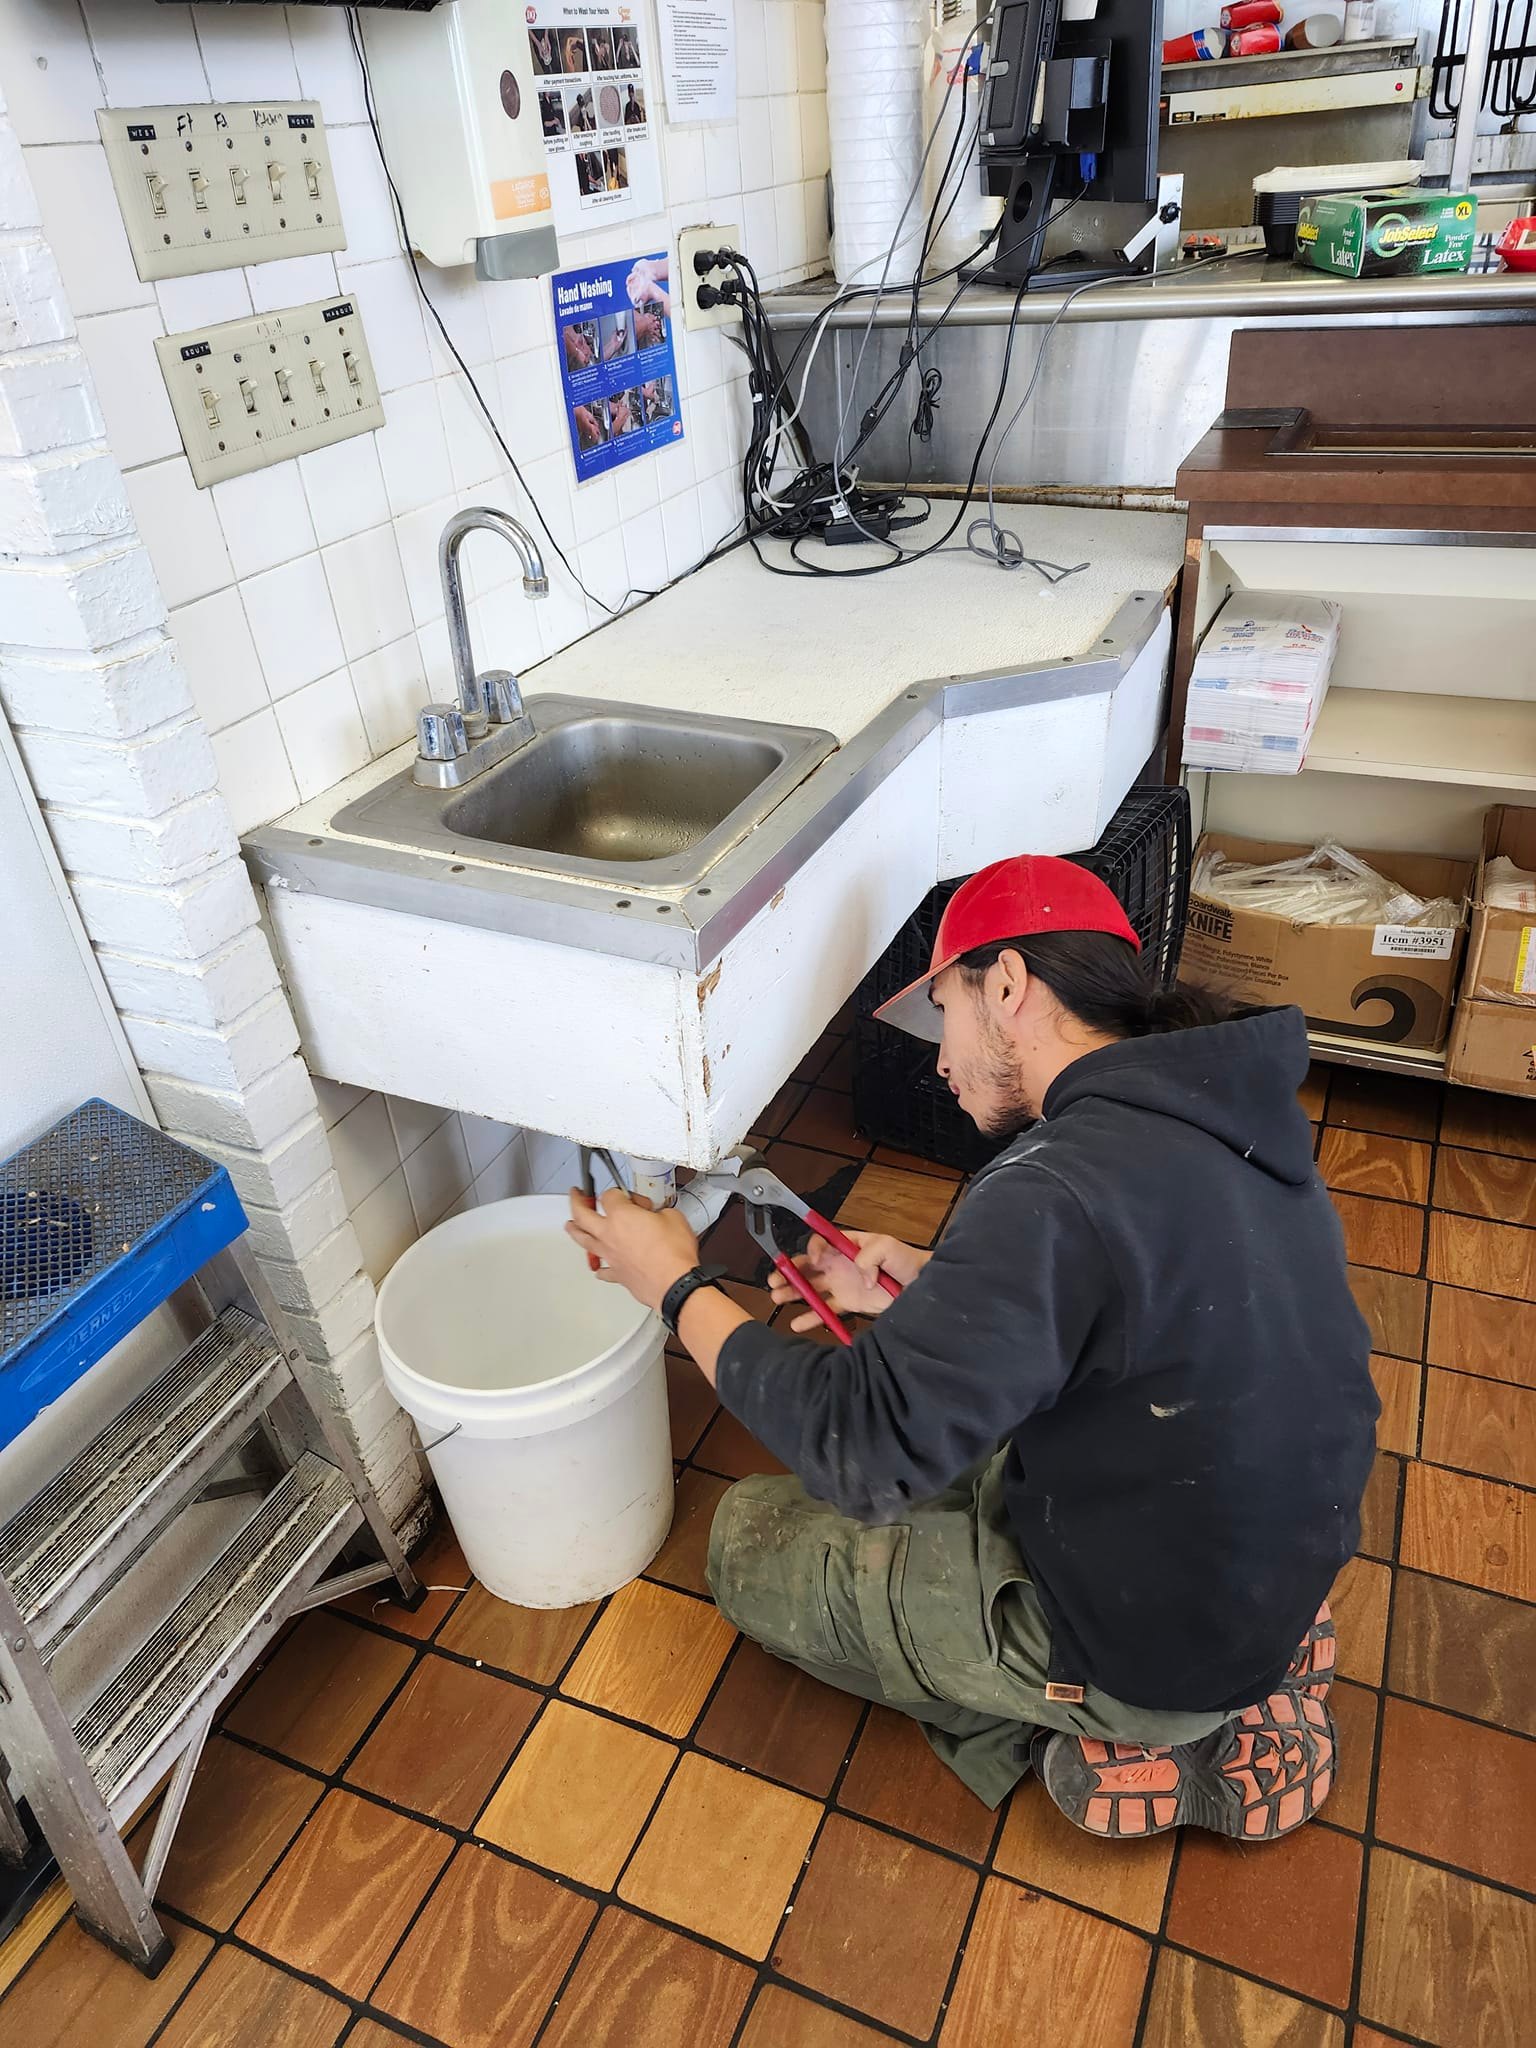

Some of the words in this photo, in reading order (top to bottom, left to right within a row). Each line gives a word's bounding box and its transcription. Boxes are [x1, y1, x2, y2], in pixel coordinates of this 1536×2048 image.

[579, 7, 588, 15] Wash
[598, 7, 609, 15] Hands
[132, 128, 155, 137] WEST
[1458, 206, 1470, 216] XL
[1379, 222, 1439, 244] JobSelect
[1445, 232, 1471, 243] Powder
[1330, 242, 1355, 269] Latex
[1422, 249, 1466, 266] Latex
[557, 283, 579, 305] Hand
[580, 277, 613, 298] Washing
[559, 306, 574, 317] Lavado
[574, 304, 580, 313] de
[580, 302, 593, 312] manos
[1187, 909, 1233, 939] KNIFE
[1383, 934, 1408, 944] Item
[1412, 936, 1444, 946] #3951
[1256, 955, 1272, 964] White
[65, 1288, 134, 1353] WERNER
